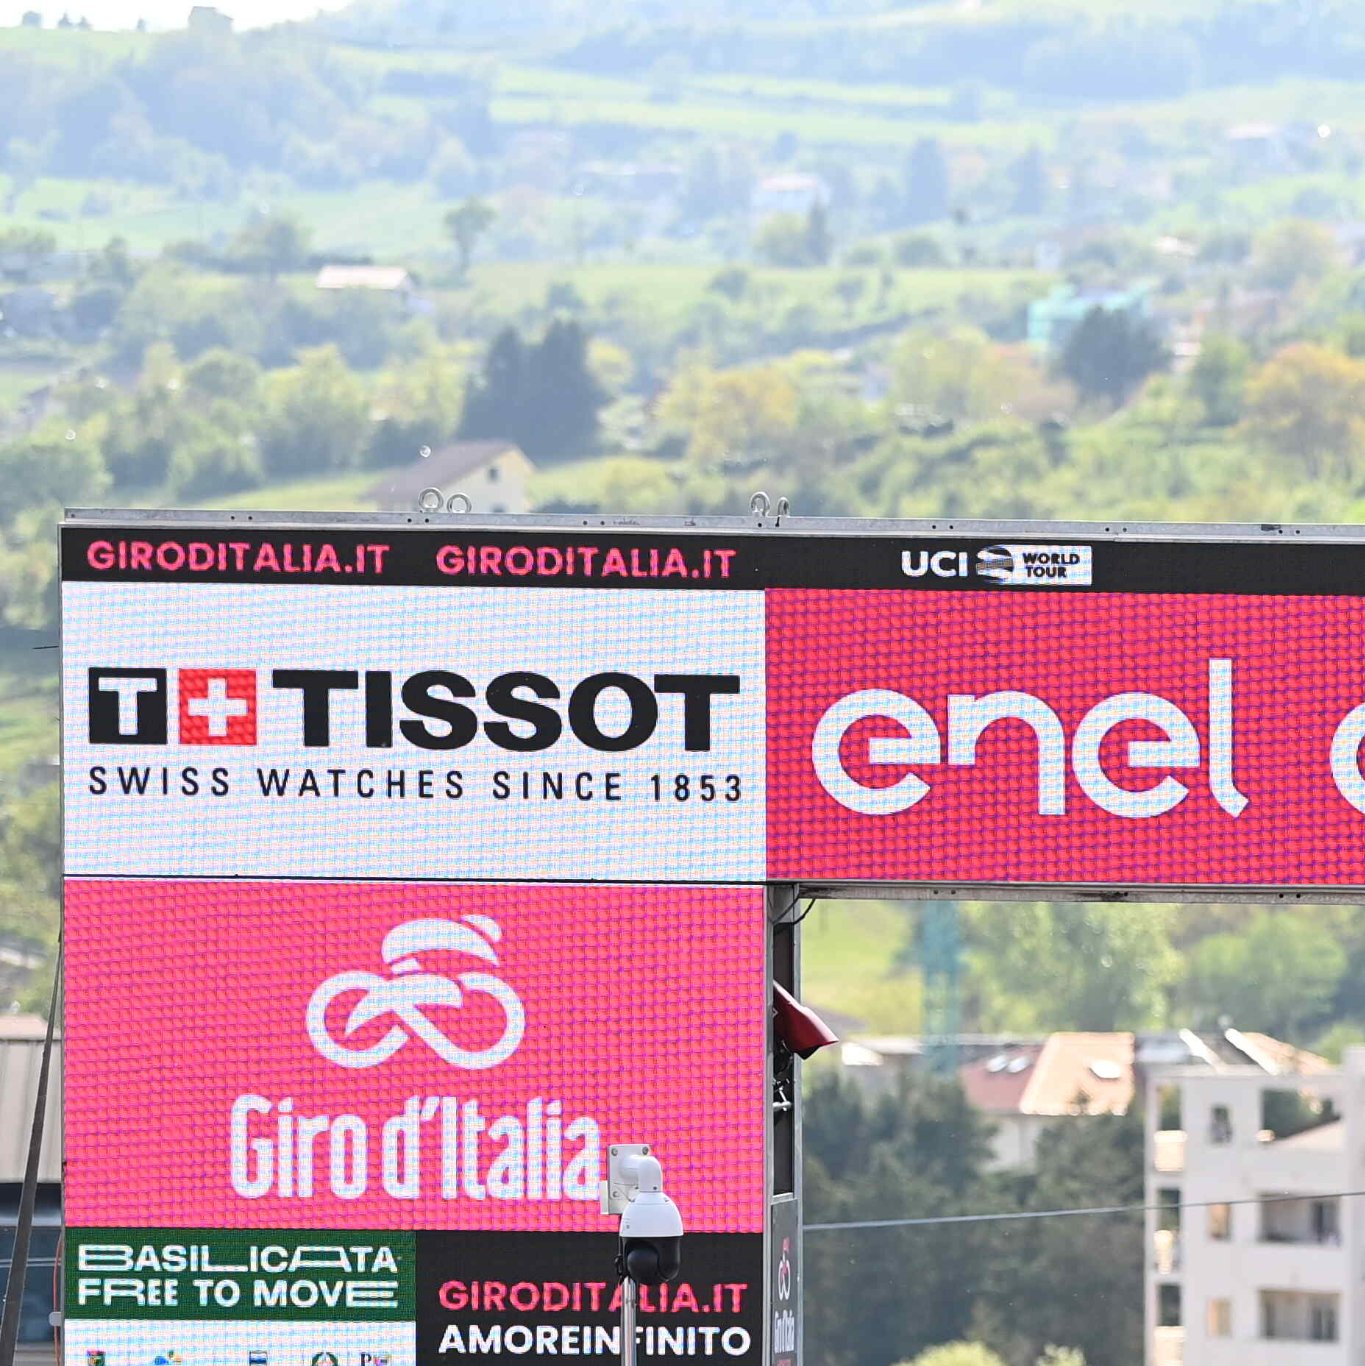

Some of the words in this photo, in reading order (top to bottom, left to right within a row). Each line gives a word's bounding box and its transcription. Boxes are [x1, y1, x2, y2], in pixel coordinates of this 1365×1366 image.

[87, 540, 390, 575] GIRODITALIA.IT
[435, 545, 737, 580] GIRODITALIA.IT
[901, 550, 968, 578] UCI
[1022, 552, 1081, 567] WORLD
[1025, 566, 1068, 579] TOUR
[272, 667, 741, 752] TISSOT
[812, 658, 1249, 819] enel
[88, 766, 232, 797] SWISS
[257, 768, 466, 799] WATCHES
[492, 771, 624, 802] SINCE
[649, 773, 744, 804] 1853
[229, 1094, 368, 1201] Giro
[382, 1095, 603, 1202] d'Italia
[78, 1243, 400, 1275] BASILICATA
[78, 1276, 179, 1309] FREE
[198, 1277, 242, 1309] TO
[253, 1277, 400, 1309] MOVE
